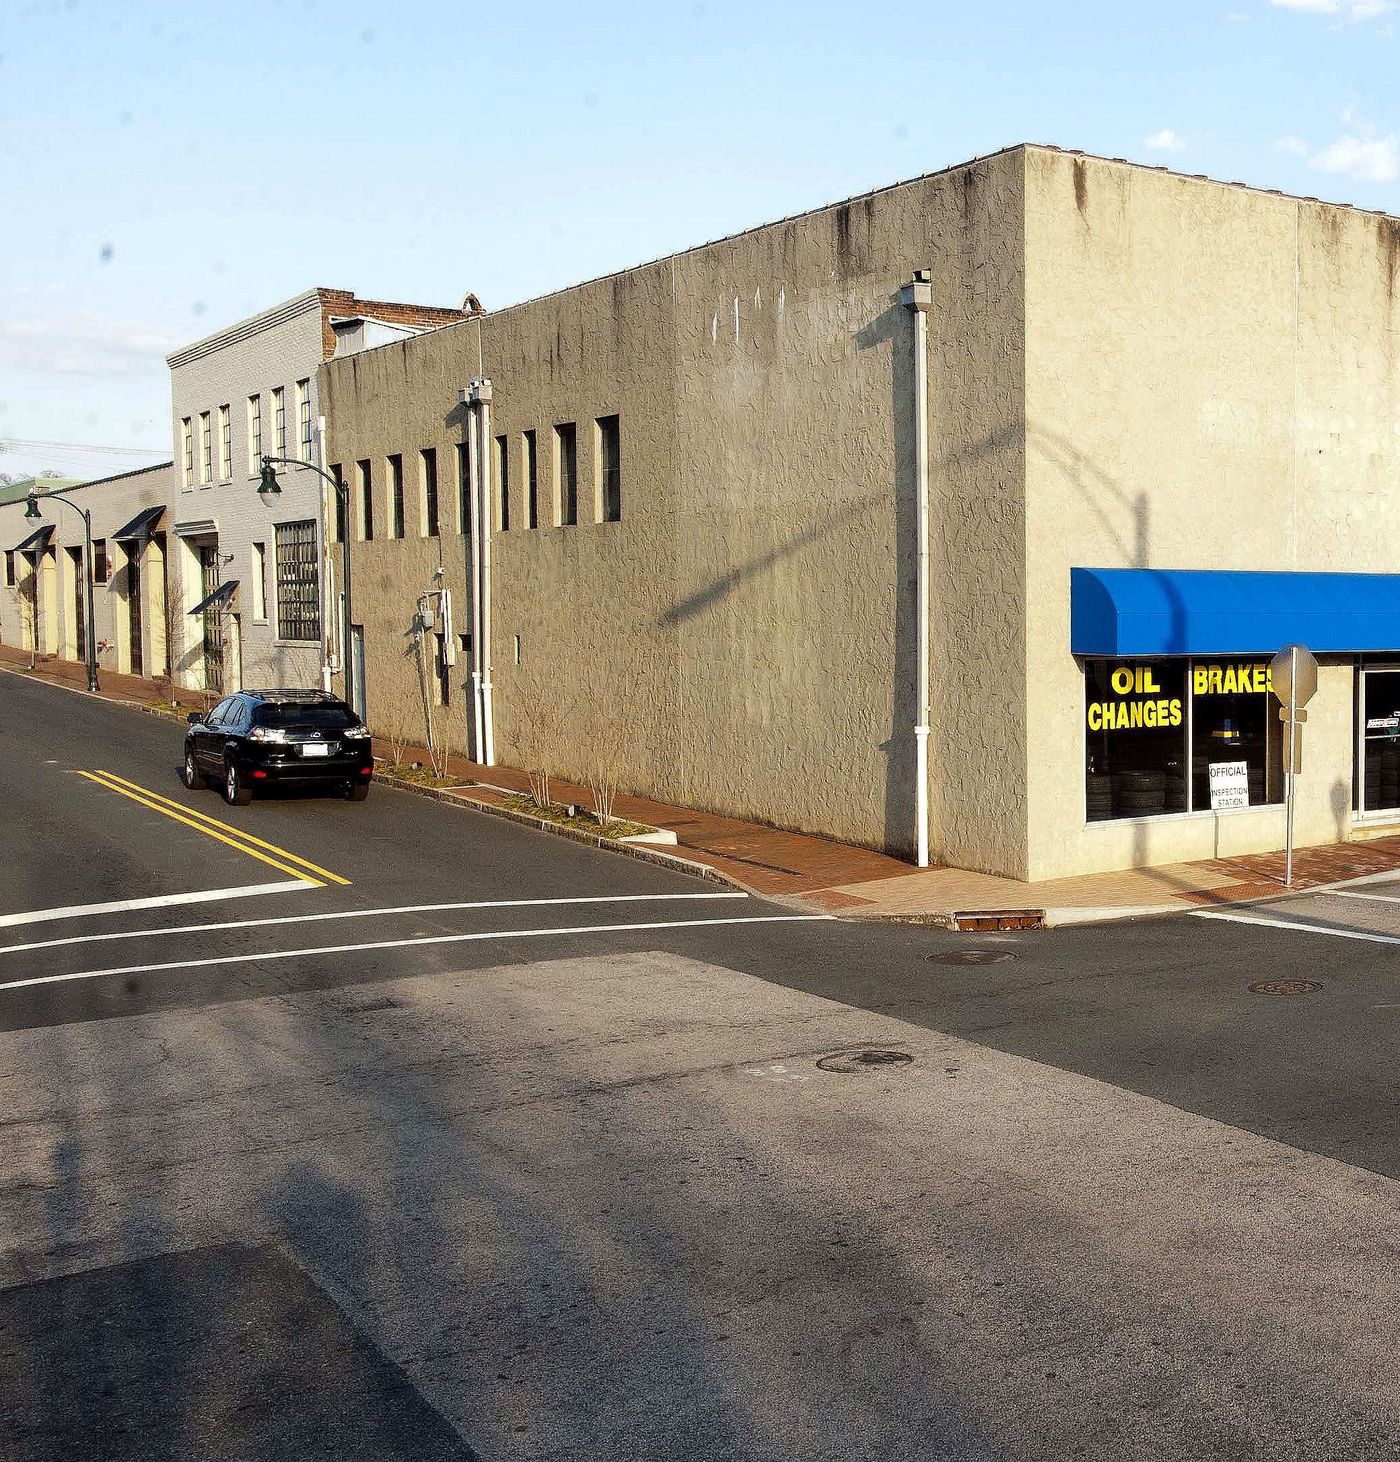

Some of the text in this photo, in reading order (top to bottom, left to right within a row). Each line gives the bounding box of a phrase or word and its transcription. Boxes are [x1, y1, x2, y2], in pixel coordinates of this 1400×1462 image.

[1111, 666, 1161, 695] OIL
[1088, 698, 1182, 732] CHANGES
[1210, 766, 1247, 778] OFFICIAL
[1211, 787, 1248, 798] INSPECTION
[1217, 798, 1243, 807] STATION
